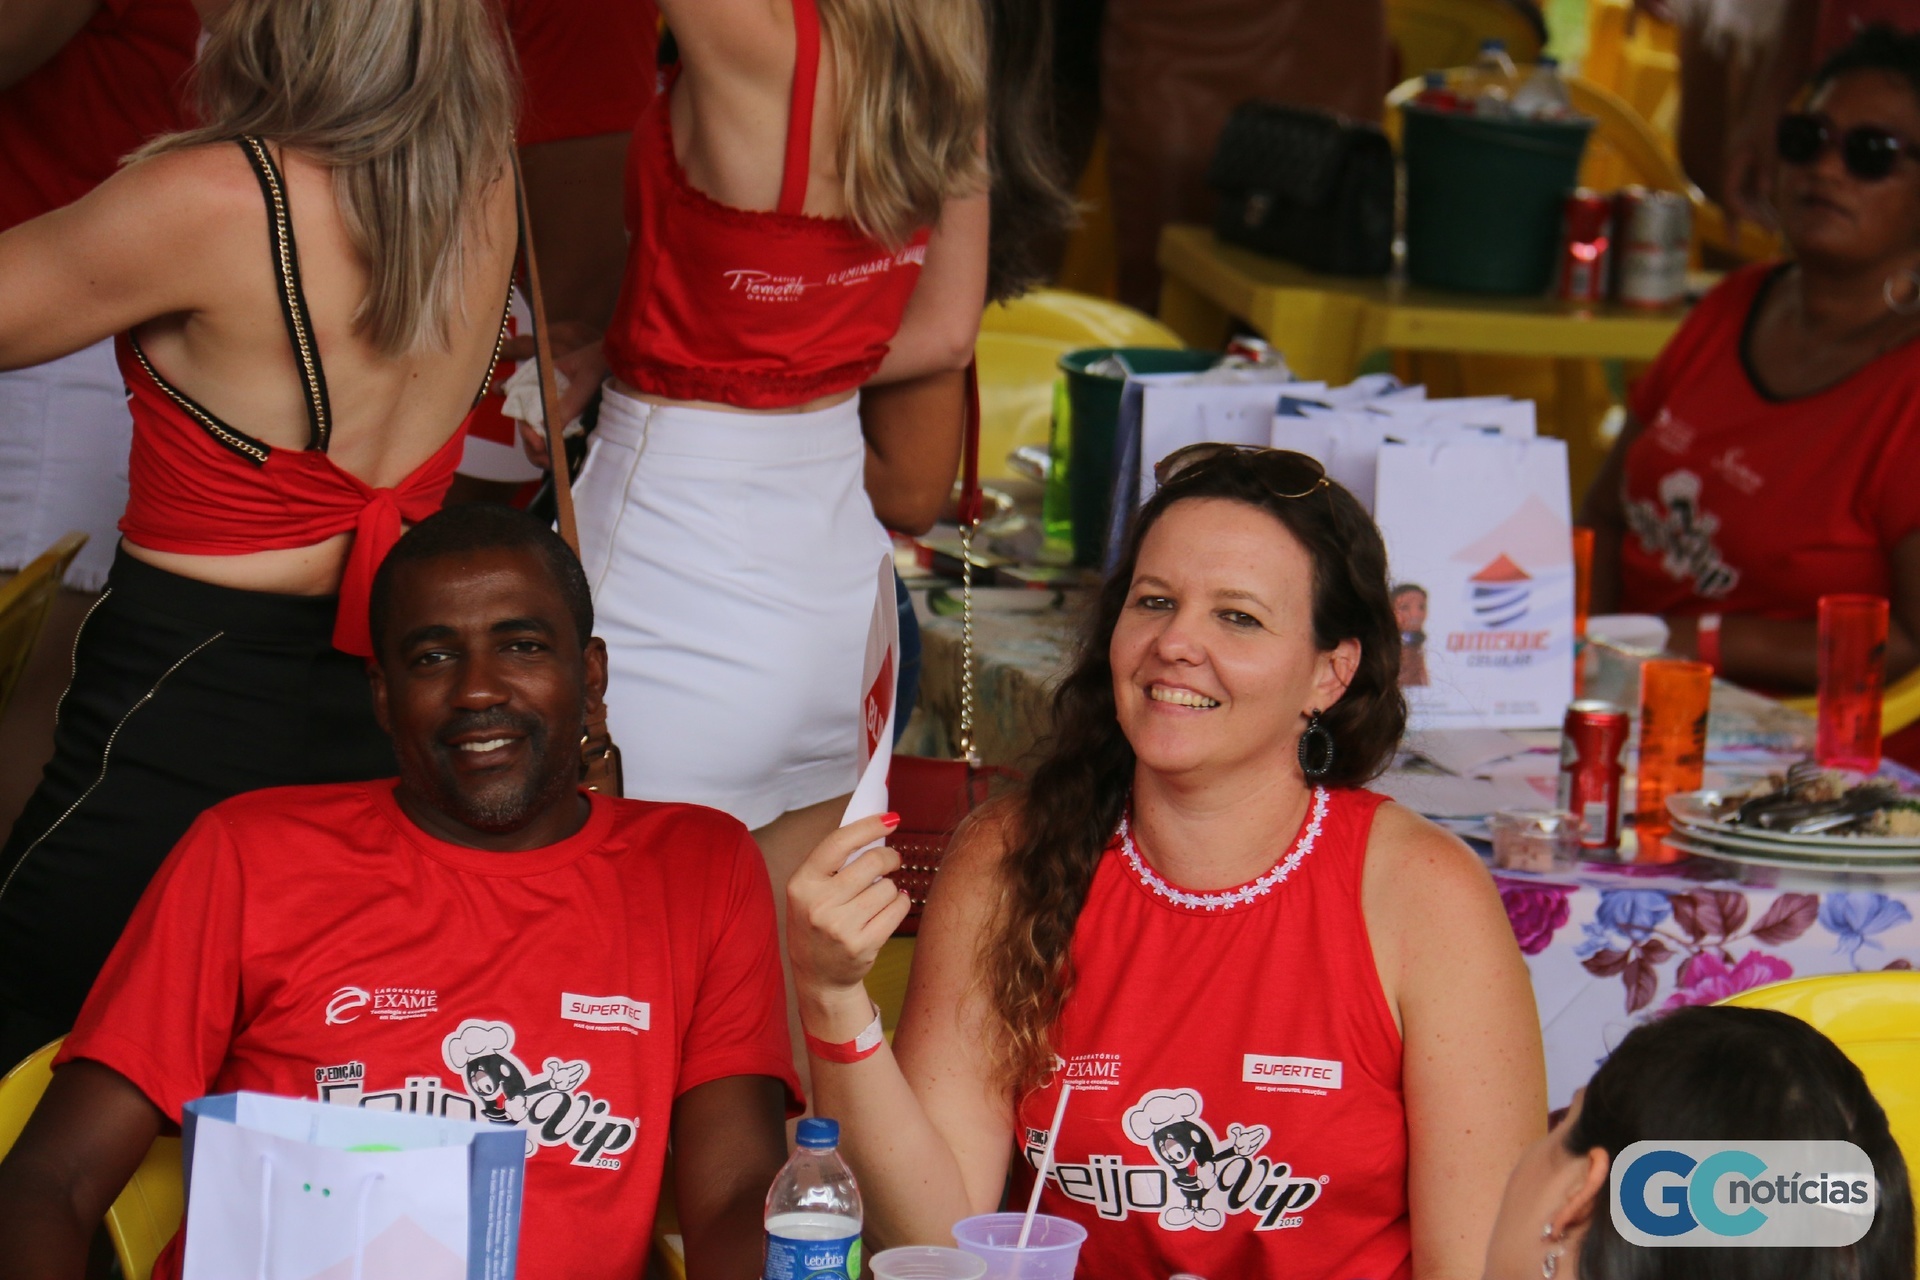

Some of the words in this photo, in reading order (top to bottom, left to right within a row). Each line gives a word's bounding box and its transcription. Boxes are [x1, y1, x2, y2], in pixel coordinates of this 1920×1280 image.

[373, 995, 437, 1009] EXAME
[570, 1002, 641, 1021] SUPERTEC
[327, 1063, 363, 1080] EDIÇÃO
[1066, 1061, 1121, 1077] EXAME
[1251, 1063, 1333, 1080] SUPERTEC
[595, 1158, 620, 1168] 2019
[1279, 1217, 1302, 1227] 2019
[804, 1252, 844, 1266] Lebrinha
